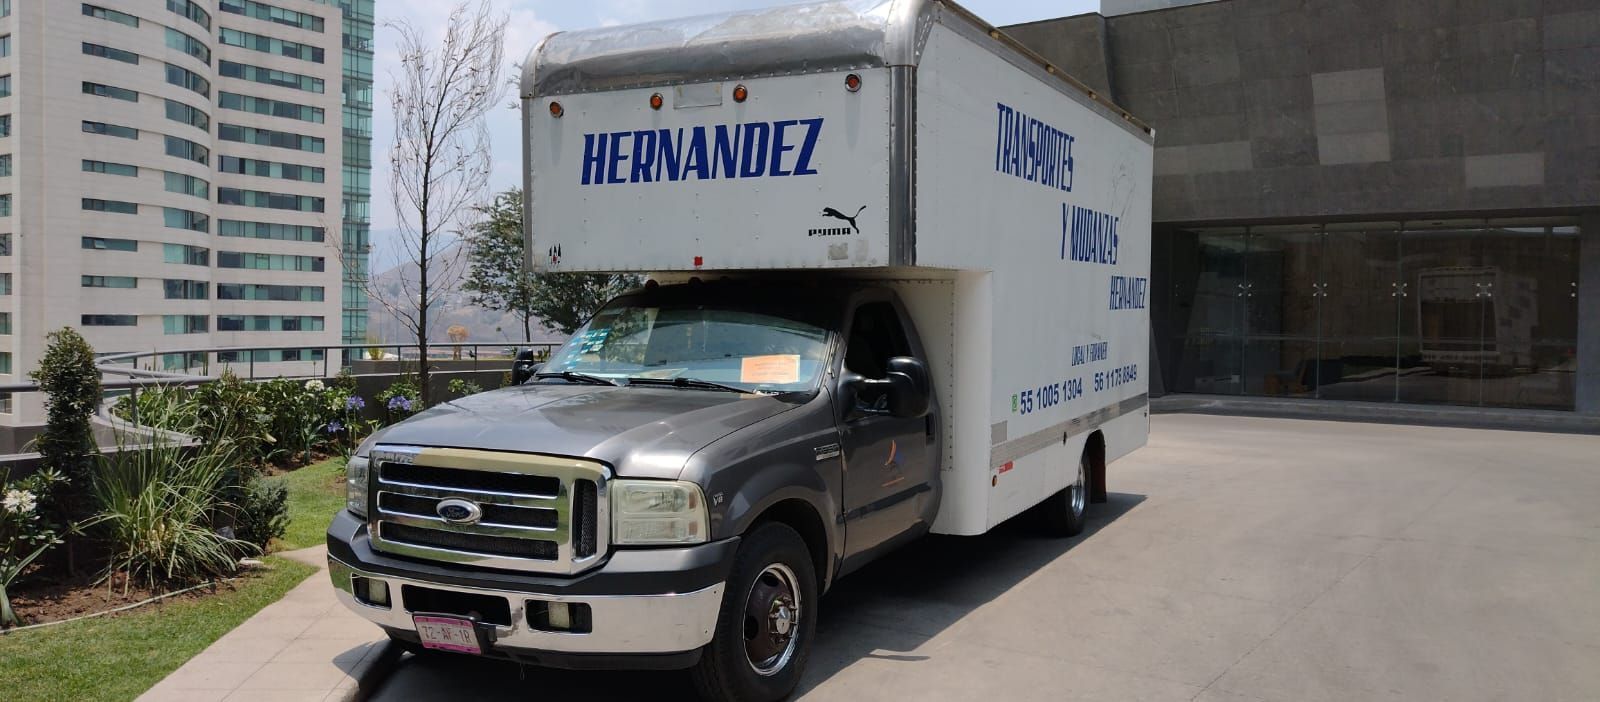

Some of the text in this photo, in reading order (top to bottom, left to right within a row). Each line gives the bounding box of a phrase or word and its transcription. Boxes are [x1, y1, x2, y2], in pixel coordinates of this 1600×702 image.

[581, 118, 824, 185] HERNANDEZ
[996, 102, 1075, 192] TRANSPORTES
[1061, 202, 1119, 265] Y MUDANZAS
[1109, 275, 1147, 310] HERNANDEZ
[1020, 390, 1033, 415] 55
[1036, 383, 1060, 410] 1005
[1063, 377, 1082, 401] 1304
[1094, 372, 1104, 393] 56
[1106, 368, 1122, 389] 1175
